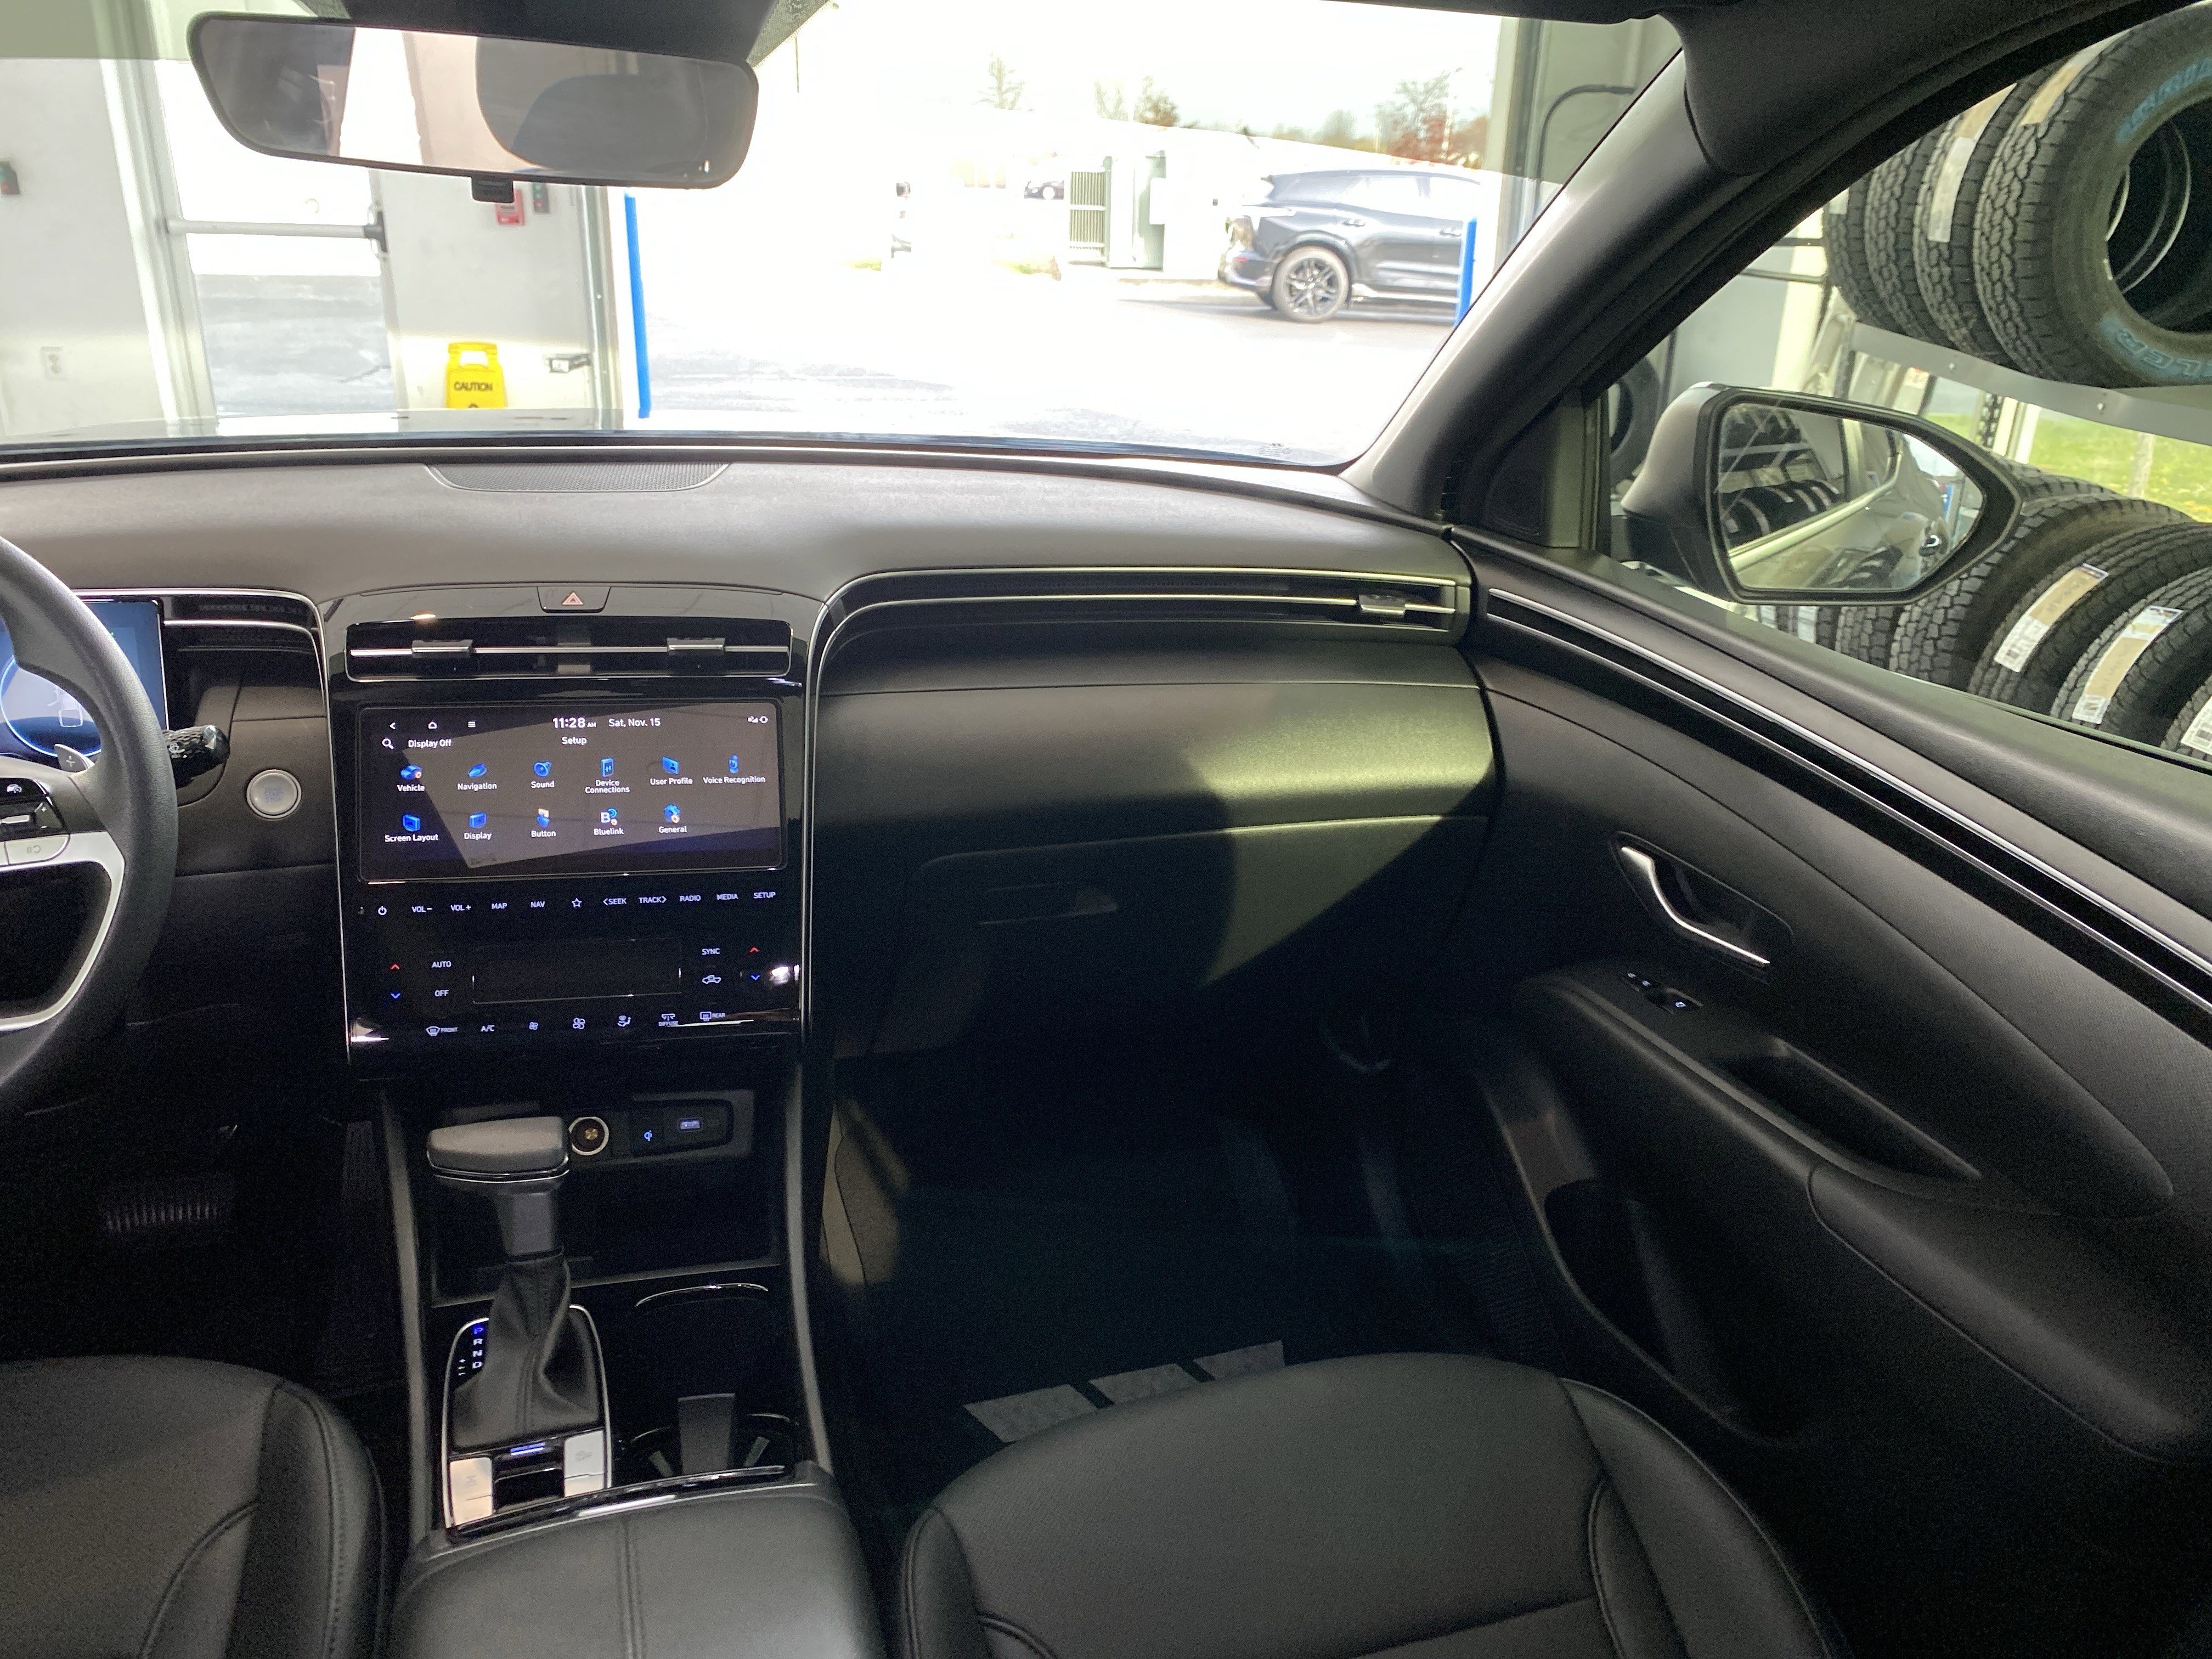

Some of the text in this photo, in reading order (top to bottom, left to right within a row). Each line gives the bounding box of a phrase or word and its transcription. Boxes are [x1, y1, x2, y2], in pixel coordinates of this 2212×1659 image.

[454, 381, 493, 392] CAUTION
[552, 717, 586, 729] 11:28
[628, 718, 648, 727] Nov.
[650, 718, 661, 727] 15
[408, 738, 452, 749] Display Off
[561, 736, 588, 746] Setup
[668, 777, 693, 785] Profile
[702, 775, 766, 785] Voice Recognition
[397, 784, 425, 792] Vehicle
[456, 782, 498, 791] Navigation
[593, 827, 624, 836] Bluelink
[658, 825, 687, 833] General
[384, 833, 439, 843] Screen Layout
[464, 831, 493, 840] Display
[531, 830, 556, 838] Button
[480, 1024, 495, 1032] A/C
[472, 1361, 483, 1369] D
